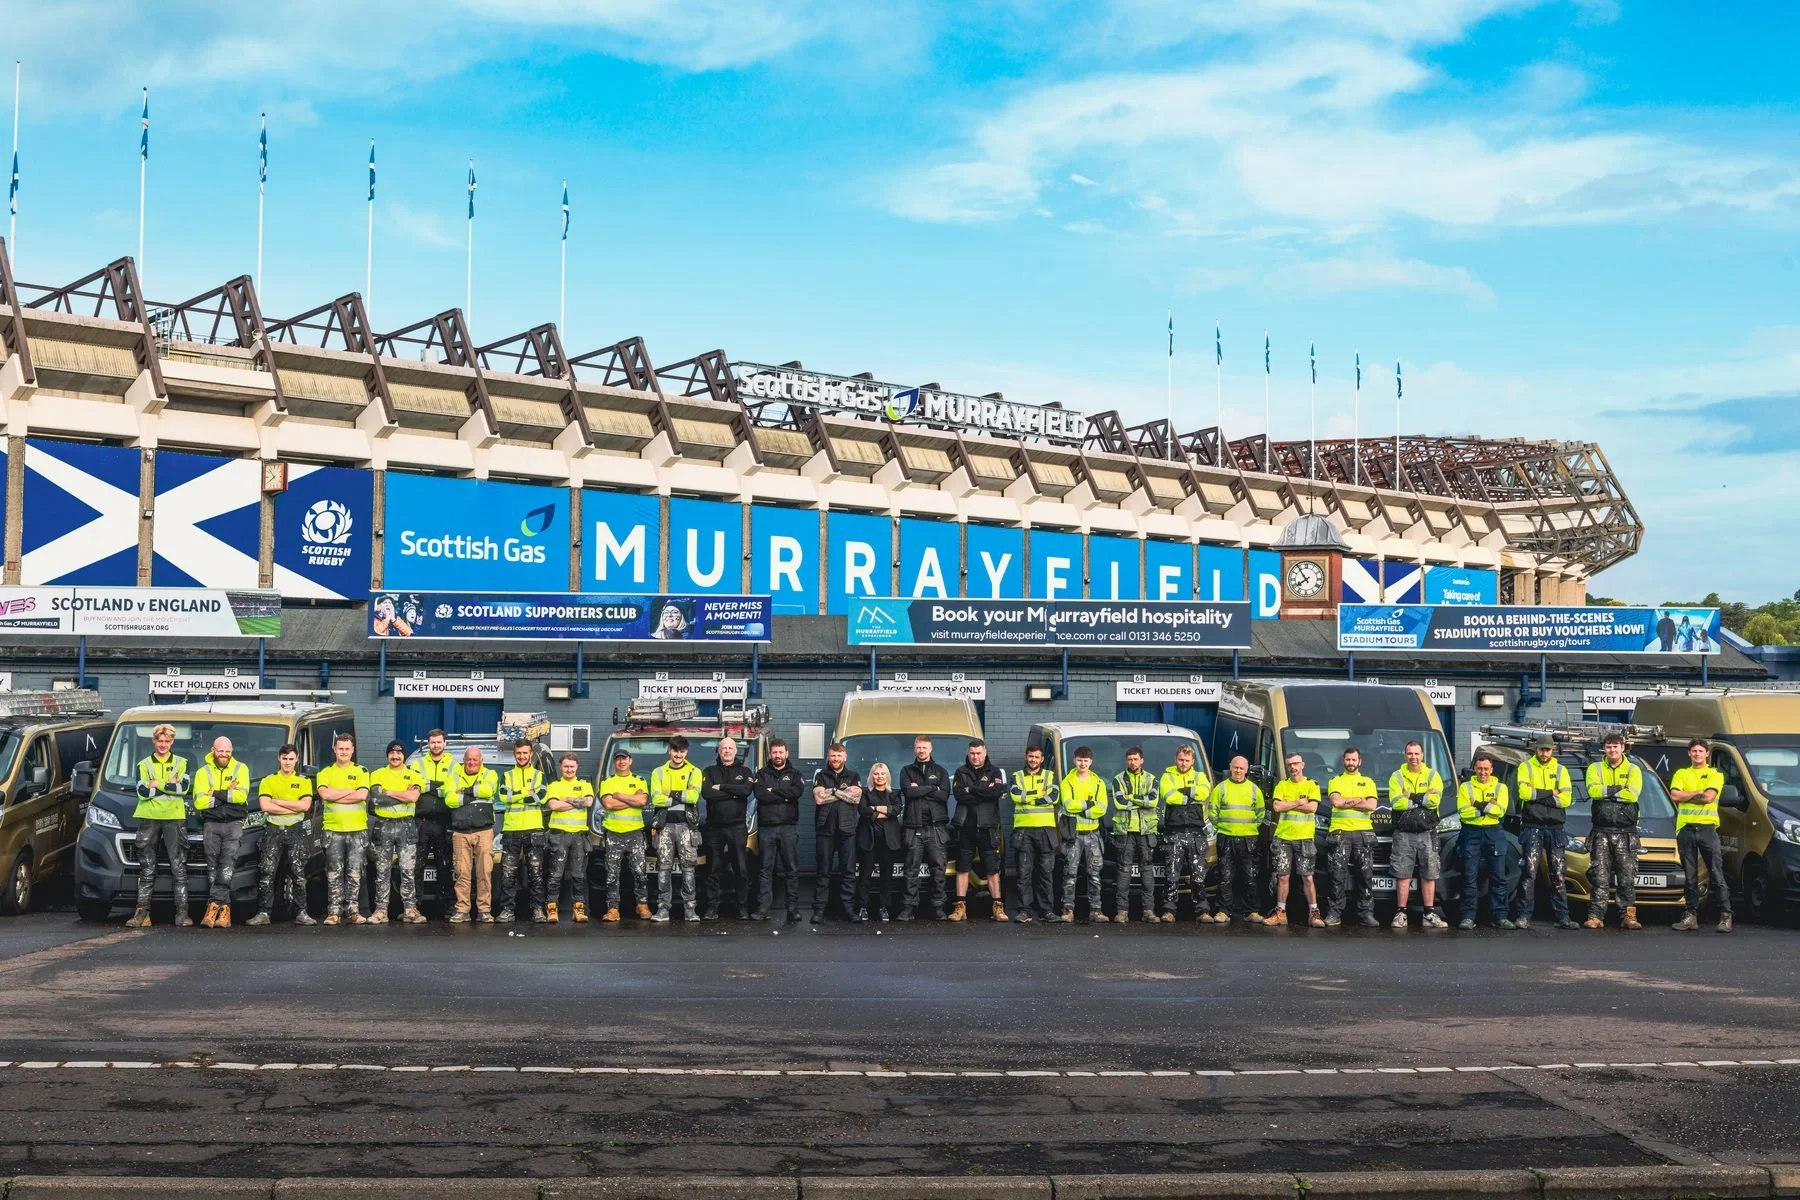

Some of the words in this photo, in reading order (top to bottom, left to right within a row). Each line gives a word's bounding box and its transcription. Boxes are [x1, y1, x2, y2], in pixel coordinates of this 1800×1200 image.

[737, 366, 838, 406] Scottish
[840, 380, 883, 411] Gas
[924, 392, 1090, 440] MURRAYFIELD
[301, 545, 352, 557] SCOTTISH
[400, 530, 498, 561] Scottish
[503, 537, 546, 564] Gas
[308, 556, 346, 567] RUGBY
[1442, 589, 1461, 602] Taking
[1461, 592, 1475, 601] care
[51, 597, 134, 612] SCOTLAND
[137, 602, 146, 612] v
[149, 599, 222, 613] ENGLAND
[704, 602, 738, 611] NEVER
[739, 601, 763, 610] MISS
[457, 605, 522, 618] SCOTLAND
[525, 606, 603, 619] SUPPORTERS
[605, 607, 637, 620] CLUB
[705, 612, 713, 621] A
[714, 611, 762, 620] MOMENT!
[932, 605, 979, 622] Book
[983, 609, 1025, 626] your
[1141, 608, 1233, 629] hospitality
[1356, 617, 1386, 626] Scottish
[1386, 617, 1401, 626] Gas
[1464, 615, 1495, 626] BOOK
[1496, 615, 1503, 625] A
[1506, 612, 1615, 625] BEHIND-THE-SCENES
[930, 630, 950, 640] visit
[1096, 633, 1108, 641] or
[1109, 632, 1127, 641] call
[1128, 632, 1150, 641] 0131
[1152, 632, 1172, 641] 346
[1174, 632, 1201, 642] 5250
[1433, 628, 1481, 639] STADIUM
[1482, 627, 1512, 638] TOUR
[1514, 627, 1529, 637] OR
[1532, 626, 1554, 637] BUY
[1554, 625, 1613, 637] VOUCHERS
[1614, 624, 1645, 635] NOW!
[1343, 636, 1383, 644] STADIUM
[1384, 637, 1415, 645] TOURS
[1489, 637, 1591, 649] scottishrugby.org/tours
[153, 680, 184, 688] TICKET
[187, 681, 229, 689] HOLDERS
[398, 683, 429, 691] TICKET
[432, 684, 474, 692] HOLDERS
[643, 685, 674, 693] TICKET
[959, 686, 982, 694] ONLY
[1123, 687, 1151, 695] TICKET
[1430, 691, 1452, 699] ONLY
[1587, 696, 1616, 704] TICKET
[1644, 876, 1661, 886] ODL
